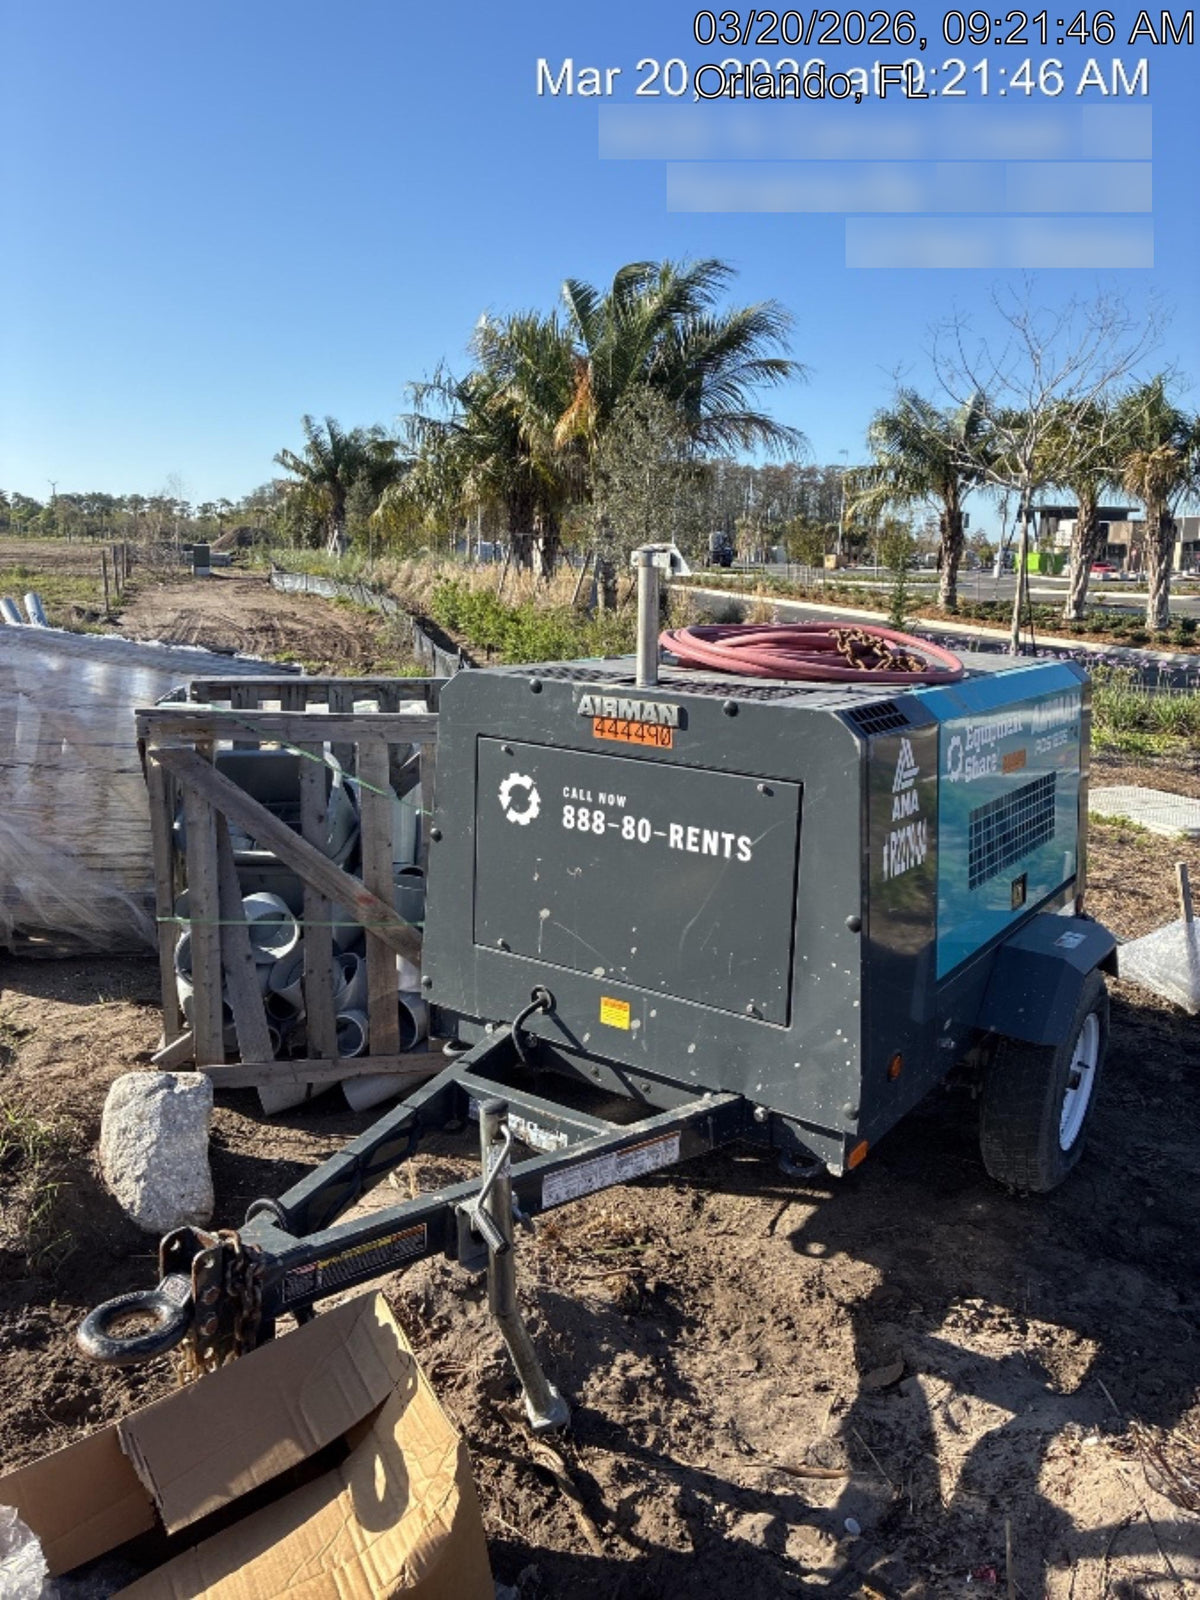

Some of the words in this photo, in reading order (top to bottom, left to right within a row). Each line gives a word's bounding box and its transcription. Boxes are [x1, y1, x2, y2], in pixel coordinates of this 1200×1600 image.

[577, 694, 681, 728] AIRMAN
[594, 718, 671, 747] 444490
[563, 786, 593, 803] CALL
[599, 792, 627, 808] NOW
[562, 804, 752, 862] 888-80-RENTS
